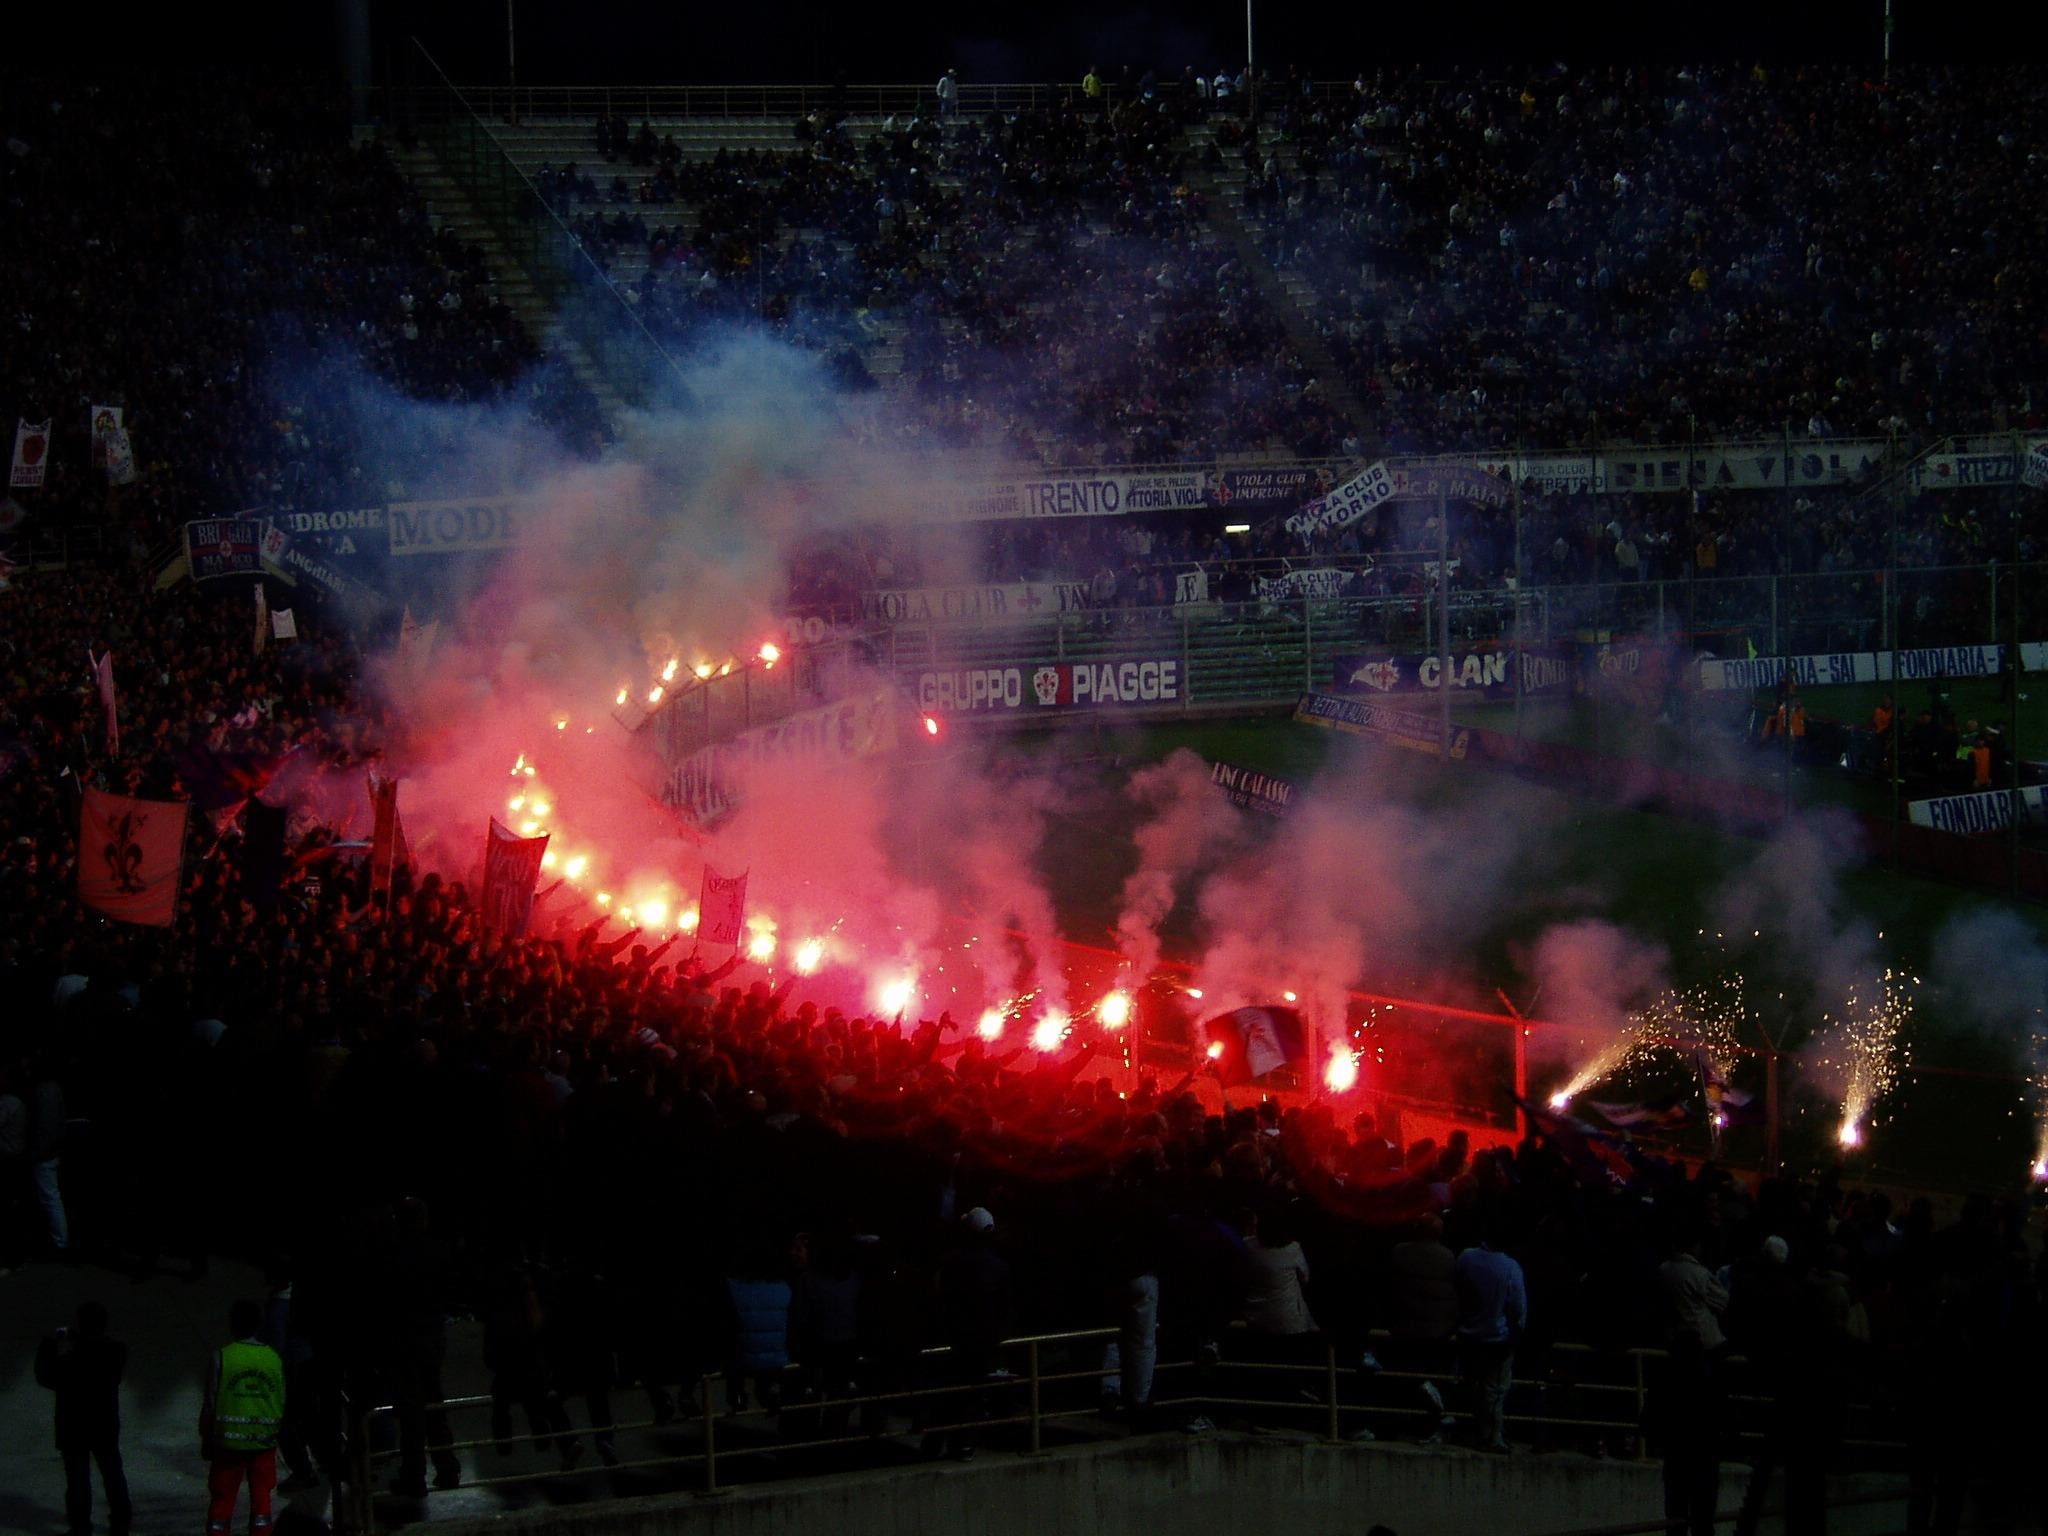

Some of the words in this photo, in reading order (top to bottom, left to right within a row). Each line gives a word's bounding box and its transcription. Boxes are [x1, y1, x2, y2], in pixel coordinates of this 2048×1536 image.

[1234, 473, 1272, 486] VIOLA
[1276, 472, 1307, 485] CLUB
[1344, 466, 1384, 498] CLUB
[1024, 480, 1119, 515] TRENTO
[919, 667, 1022, 710] GRUPPO
[1073, 660, 1178, 704] PIAGGE
[1418, 650, 1508, 688] CLAN
[1723, 655, 1856, 689] FONDIARIA-SAI
